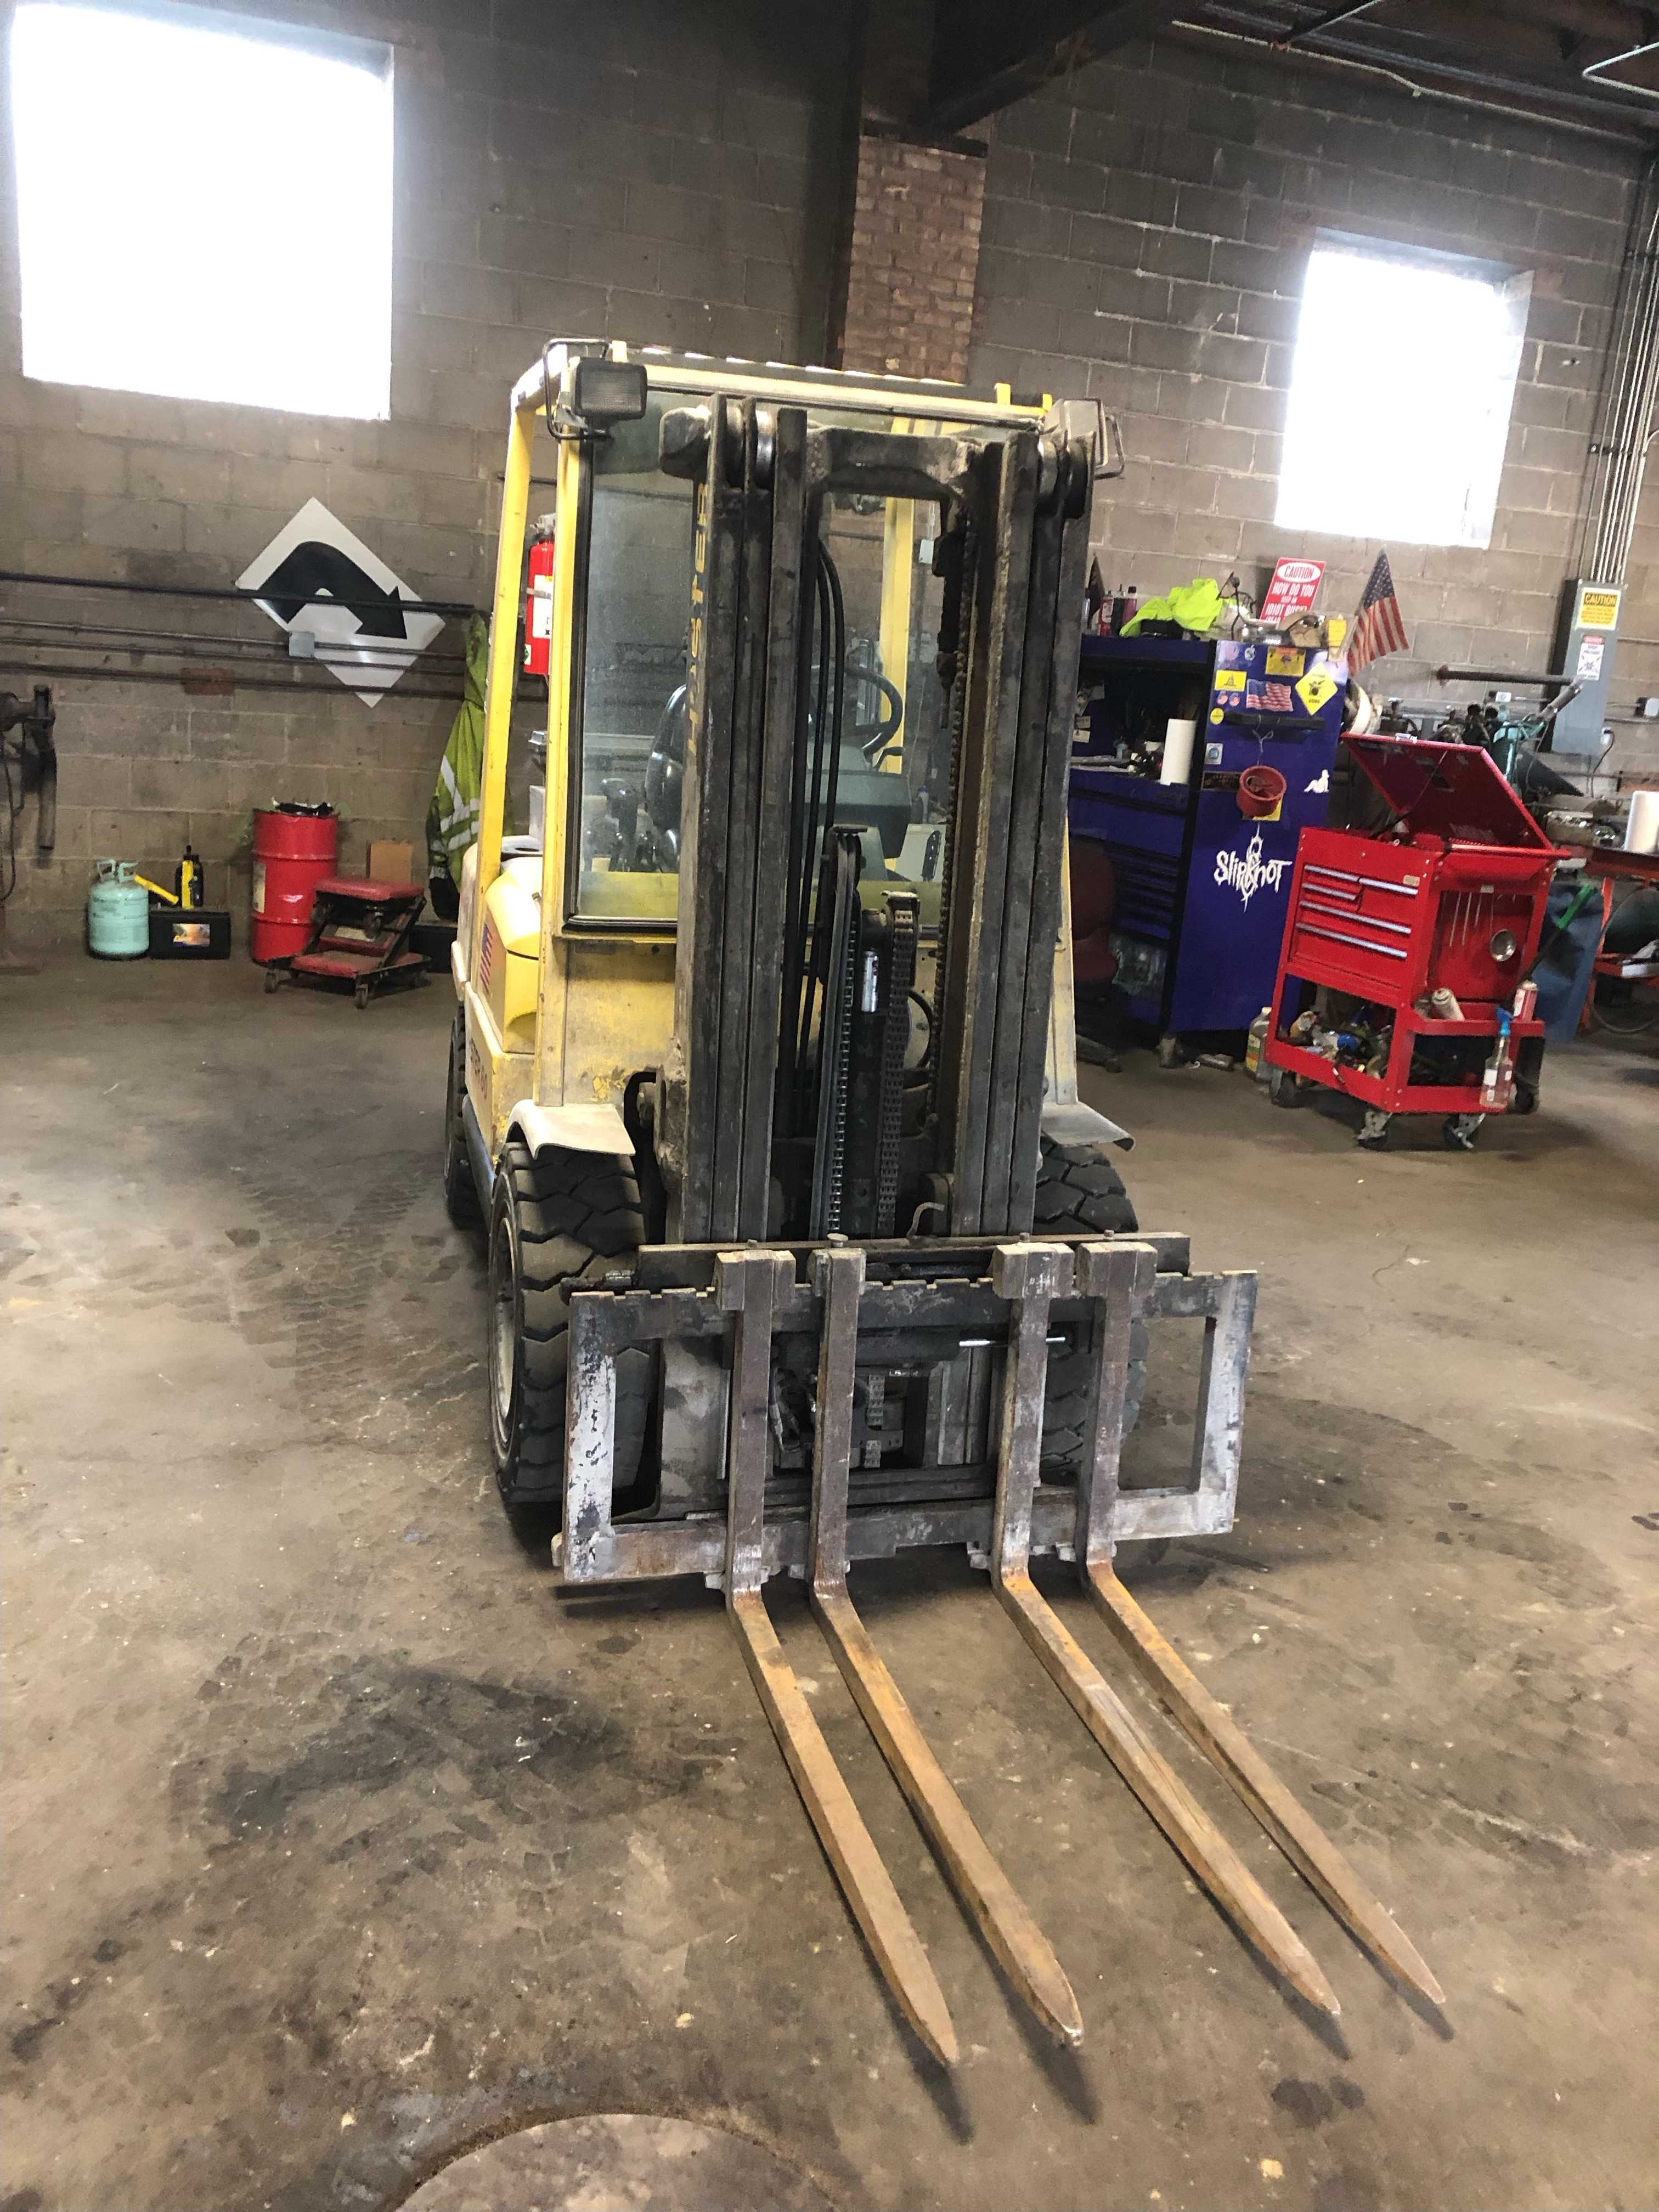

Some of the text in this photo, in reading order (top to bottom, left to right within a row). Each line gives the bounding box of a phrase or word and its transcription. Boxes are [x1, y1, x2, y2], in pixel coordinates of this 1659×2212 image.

[1284, 566, 1314, 579] CAUTION
[1272, 582, 1315, 597] HOW DO YOU
[1585, 594, 1617, 606] CAUTION
[1265, 603, 1285, 616] IDIOT
